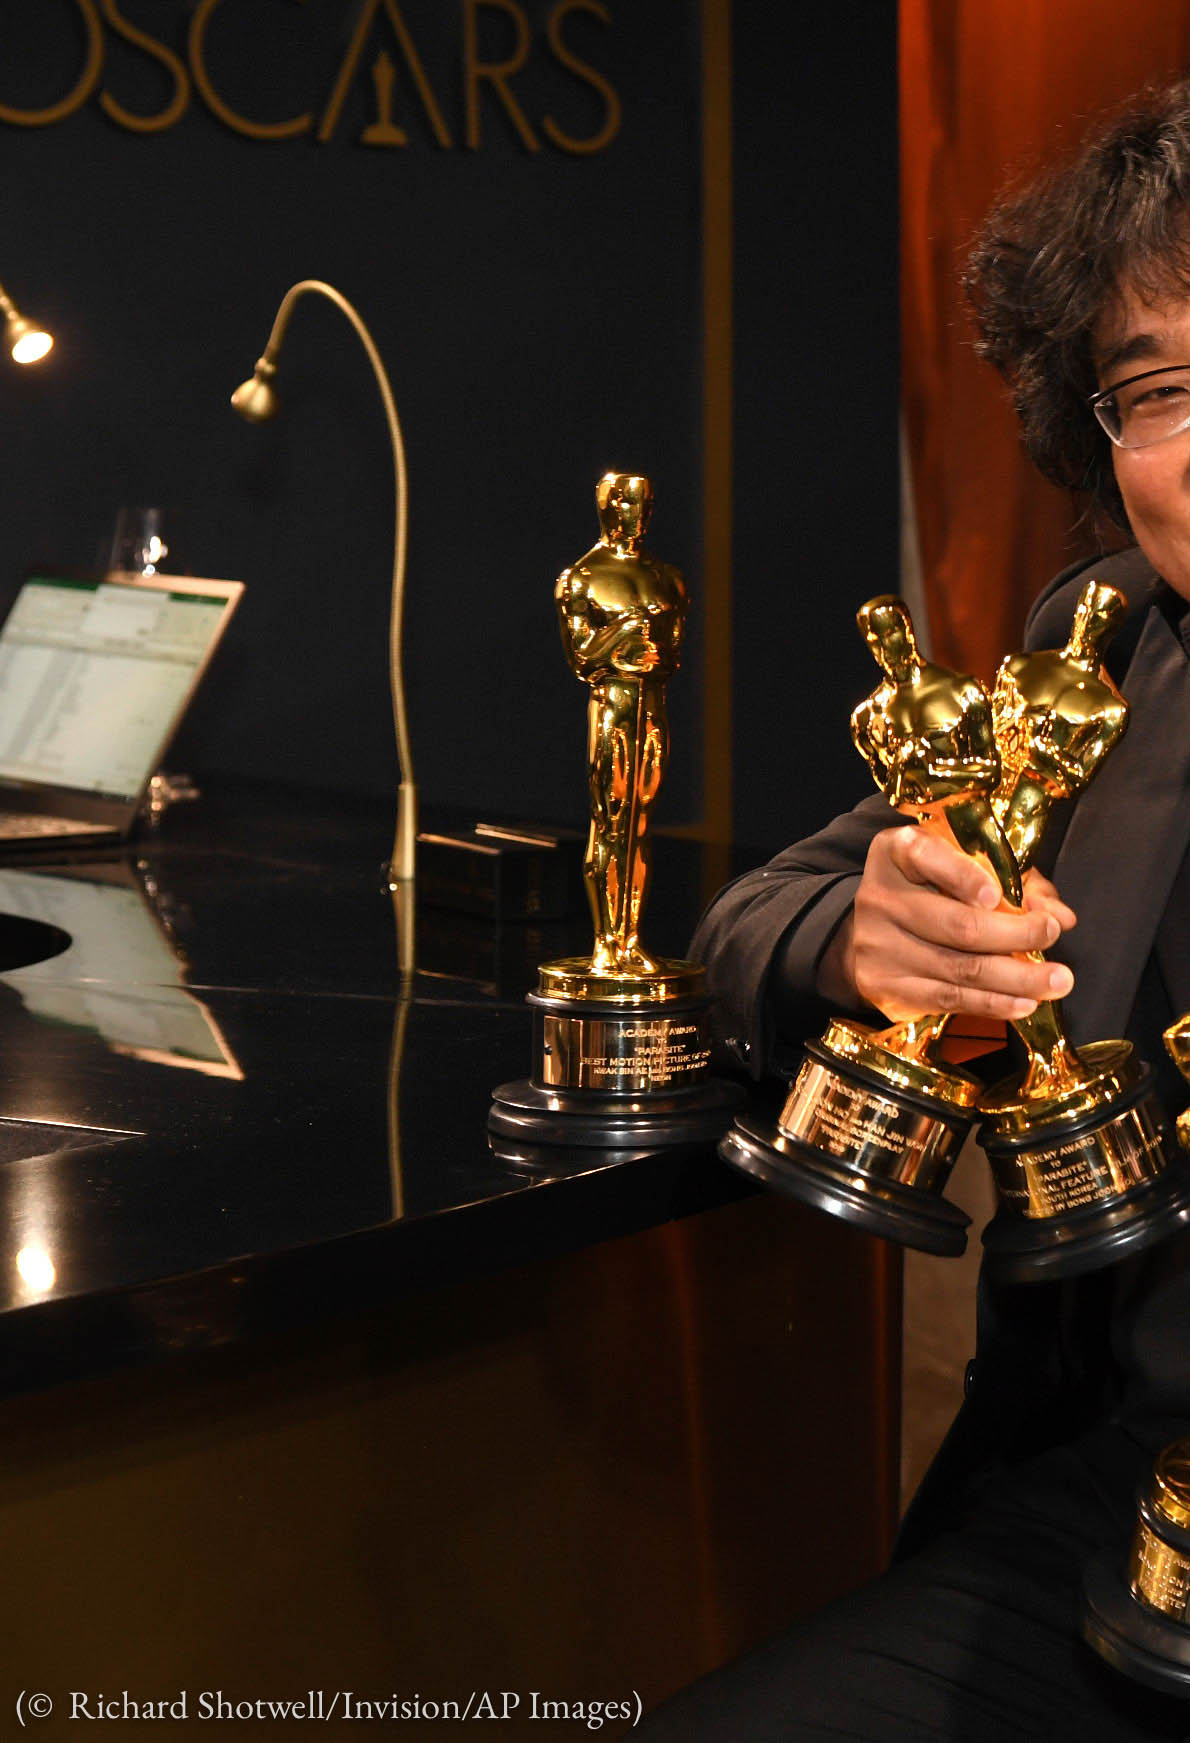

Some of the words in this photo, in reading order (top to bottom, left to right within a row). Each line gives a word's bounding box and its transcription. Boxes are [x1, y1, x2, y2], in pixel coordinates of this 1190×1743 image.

[0, 0, 621, 153] OSCARS
[618, 1028, 666, 1037] ACADEMY
[609, 1057, 650, 1066] MOTION
[1060, 1137, 1096, 1156] AWARD
[1051, 1161, 1061, 1169] TO
[1062, 1166, 1109, 1188] FEATURE
[1068, 1195, 1092, 1208] BONG
